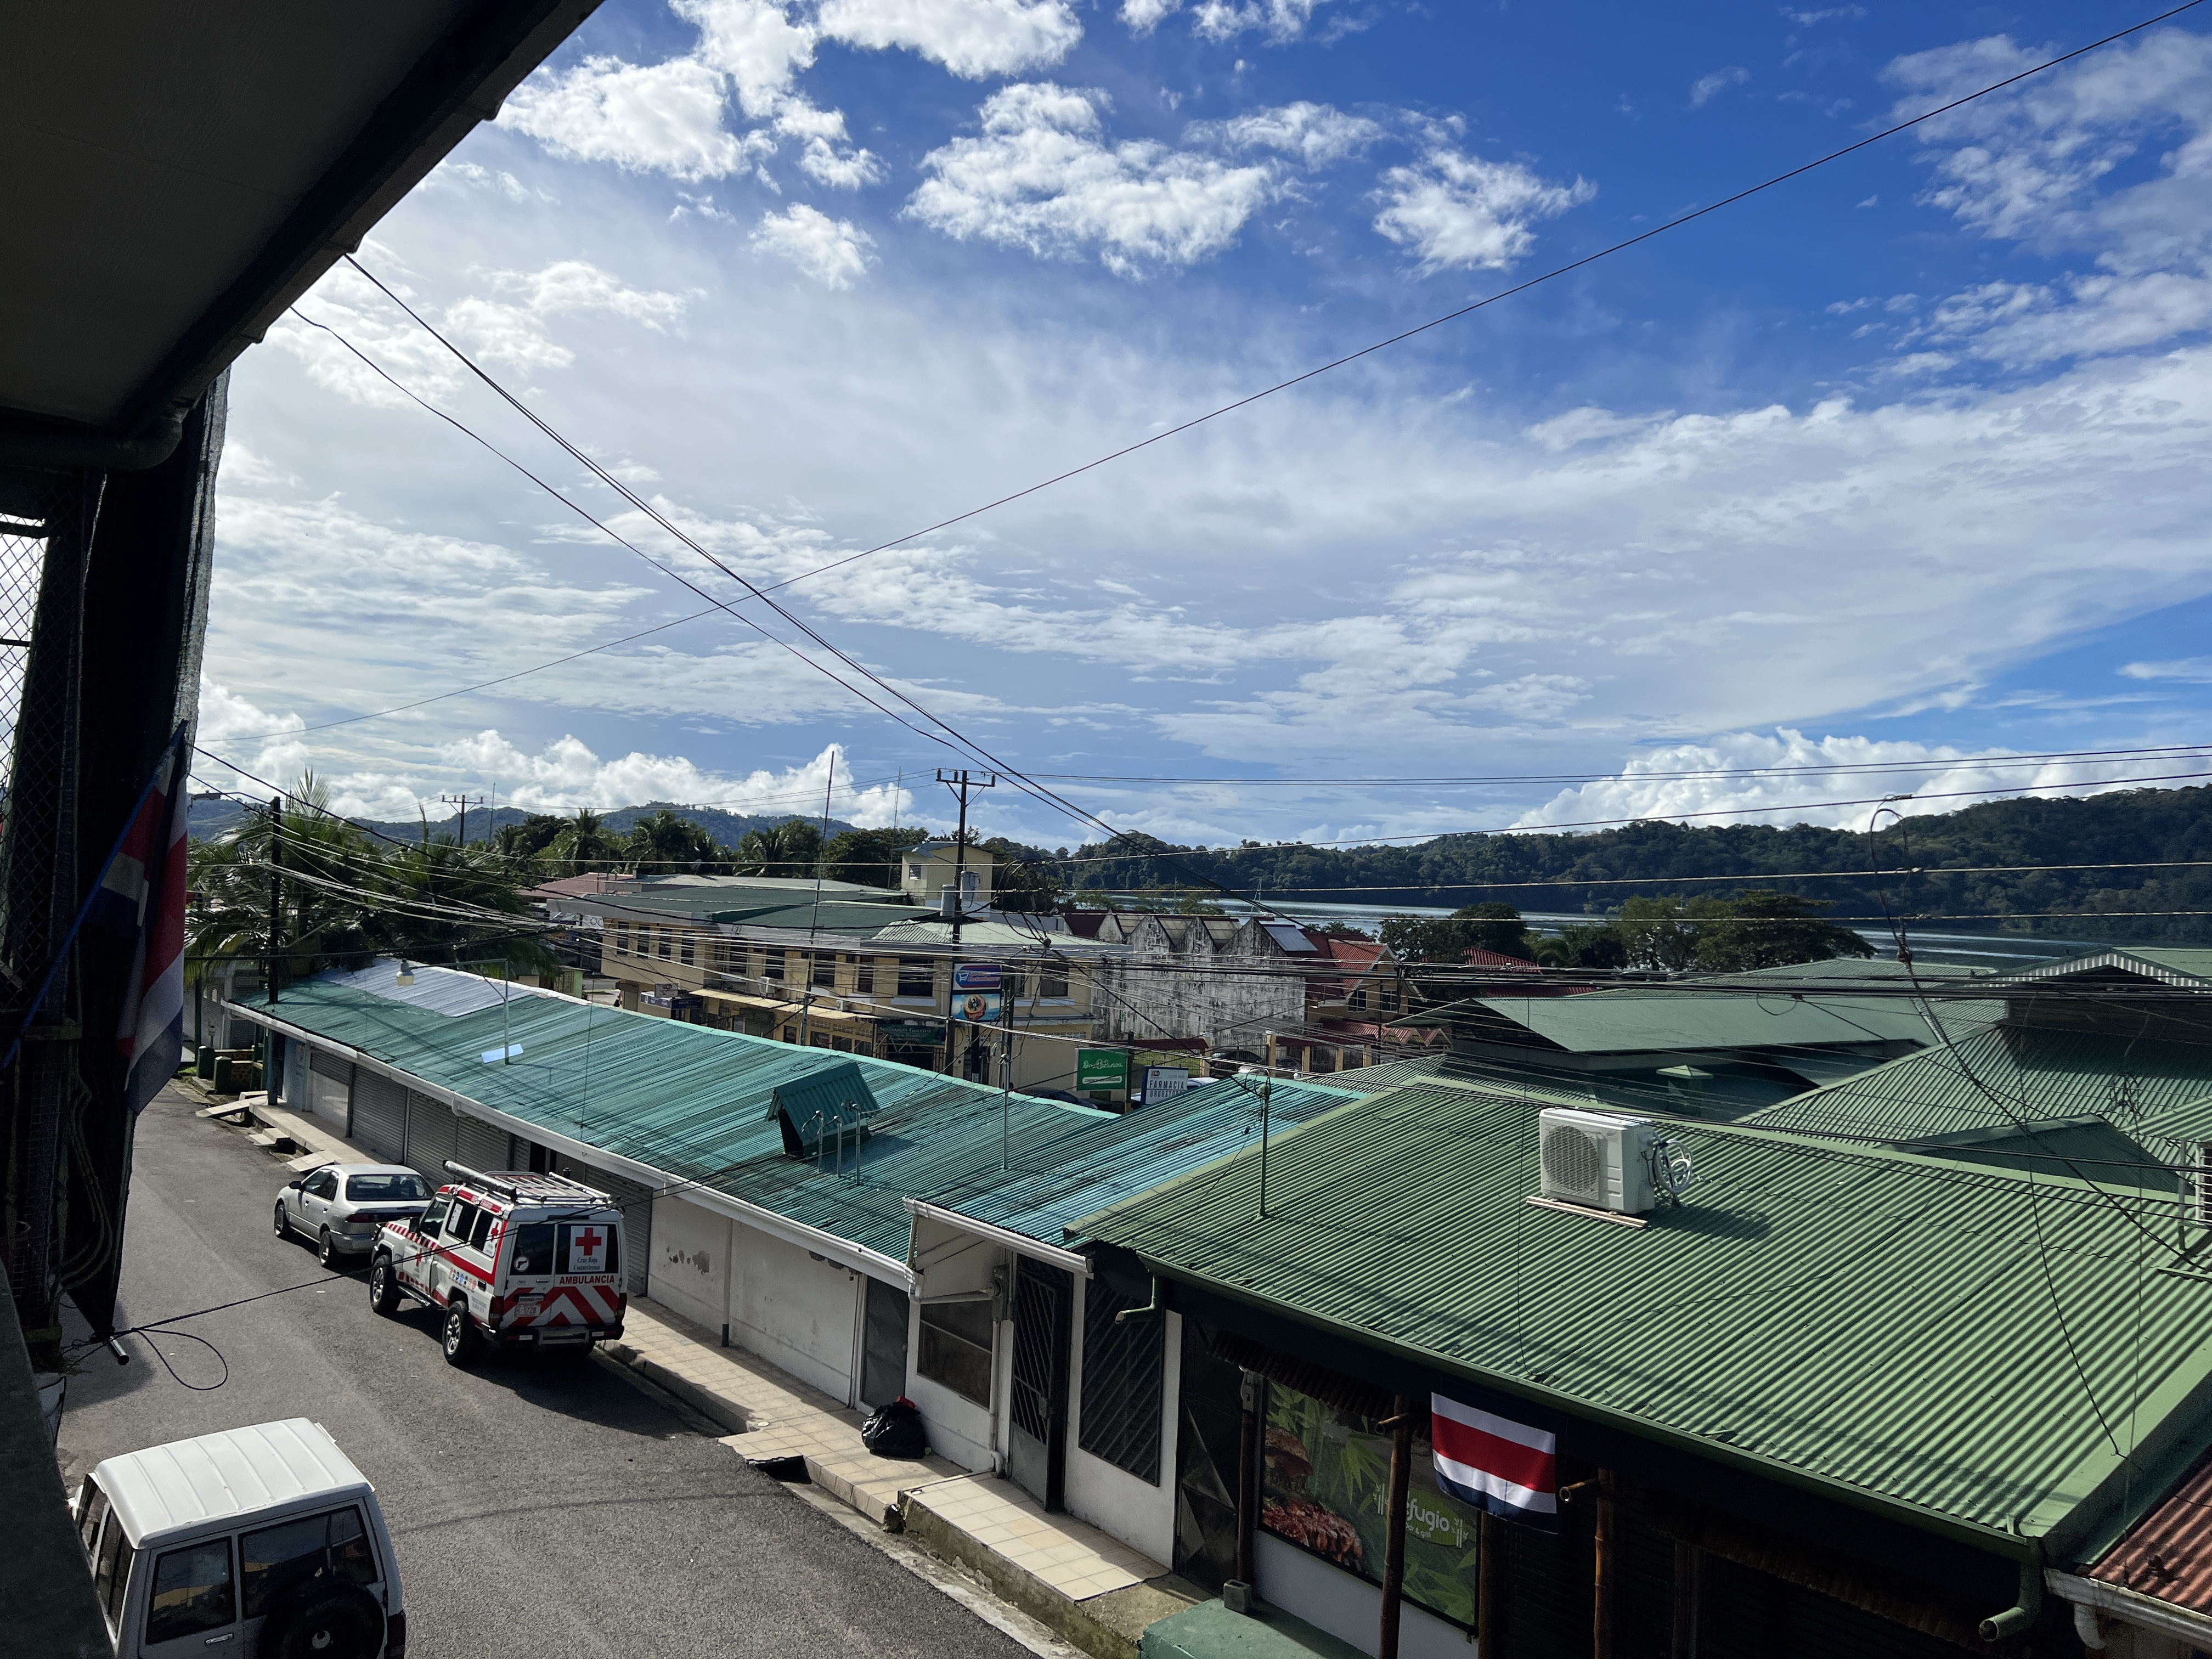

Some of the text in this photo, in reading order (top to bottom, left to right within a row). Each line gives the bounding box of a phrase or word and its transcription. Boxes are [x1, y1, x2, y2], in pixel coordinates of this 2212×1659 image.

[1149, 1080, 1184, 1090] FARMACIA
[559, 1275, 615, 1284] AMBULANCIA
[1406, 1498, 1450, 1532] fugio
